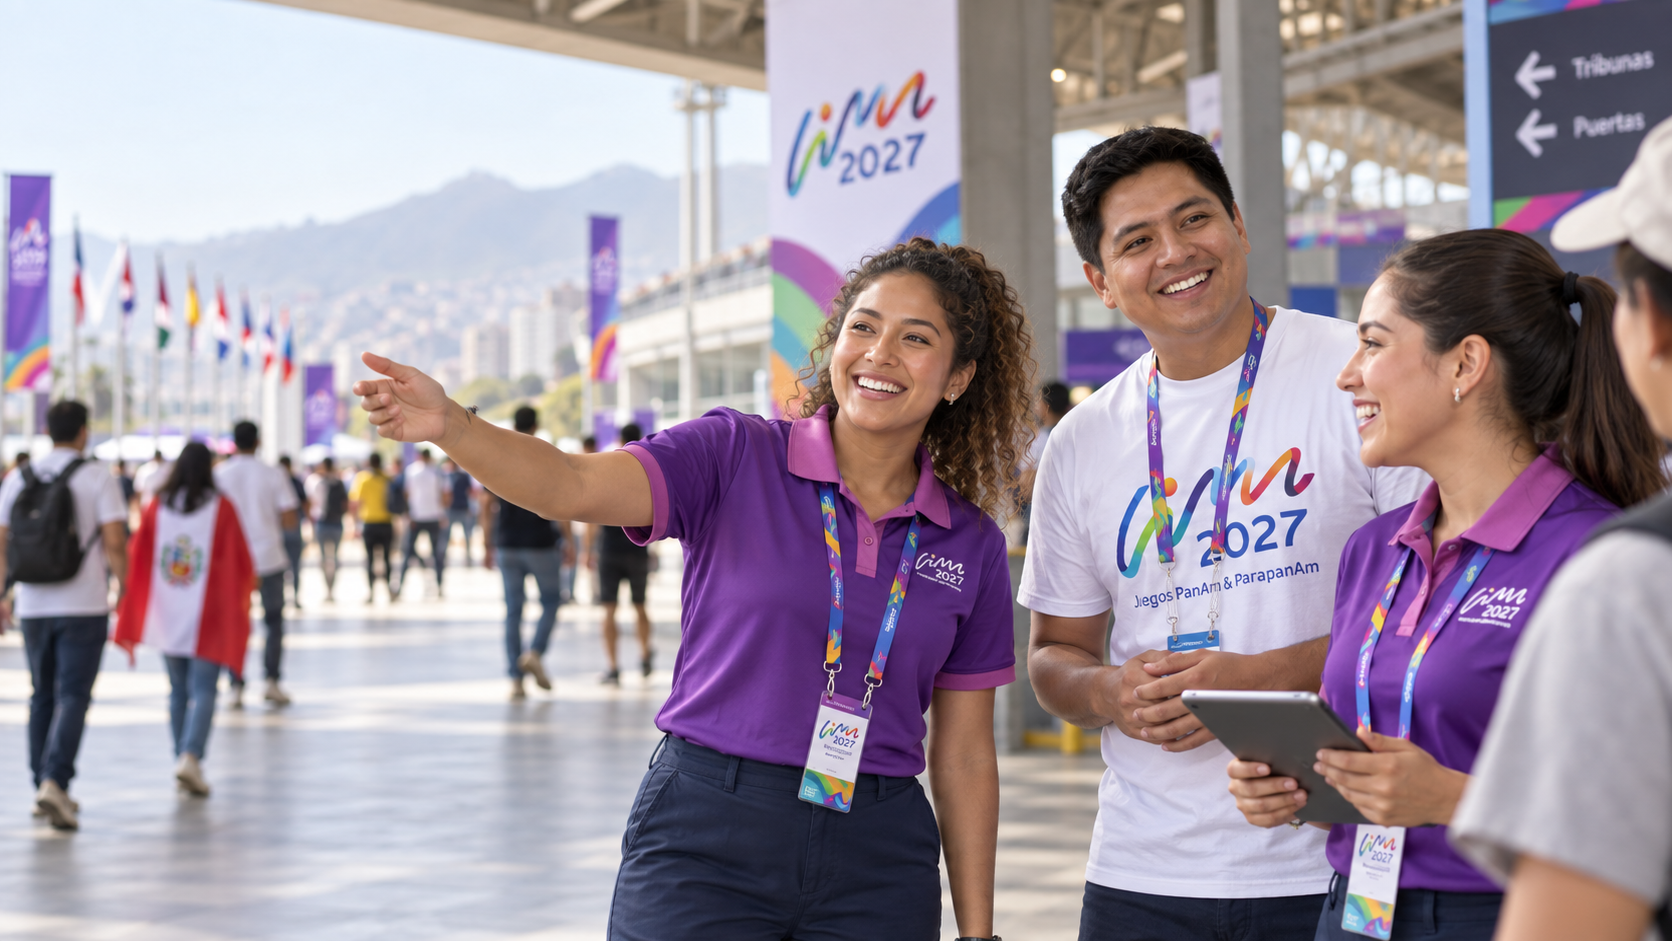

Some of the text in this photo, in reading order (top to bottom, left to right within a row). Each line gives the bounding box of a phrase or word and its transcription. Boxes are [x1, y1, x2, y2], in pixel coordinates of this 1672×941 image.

[1571, 50, 1654, 79] Tribunas
[1573, 112, 1645, 139] Puertas
[839, 132, 926, 185] 2027
[1197, 508, 1308, 567] 2027
[935, 568, 964, 586] 2027
[1223, 576, 1233, 590] &
[1234, 561, 1320, 587] ParapanAm
[1481, 604, 1520, 620] 2027
[833, 735, 856, 748] 2027
[1371, 850, 1394, 864] 2027
